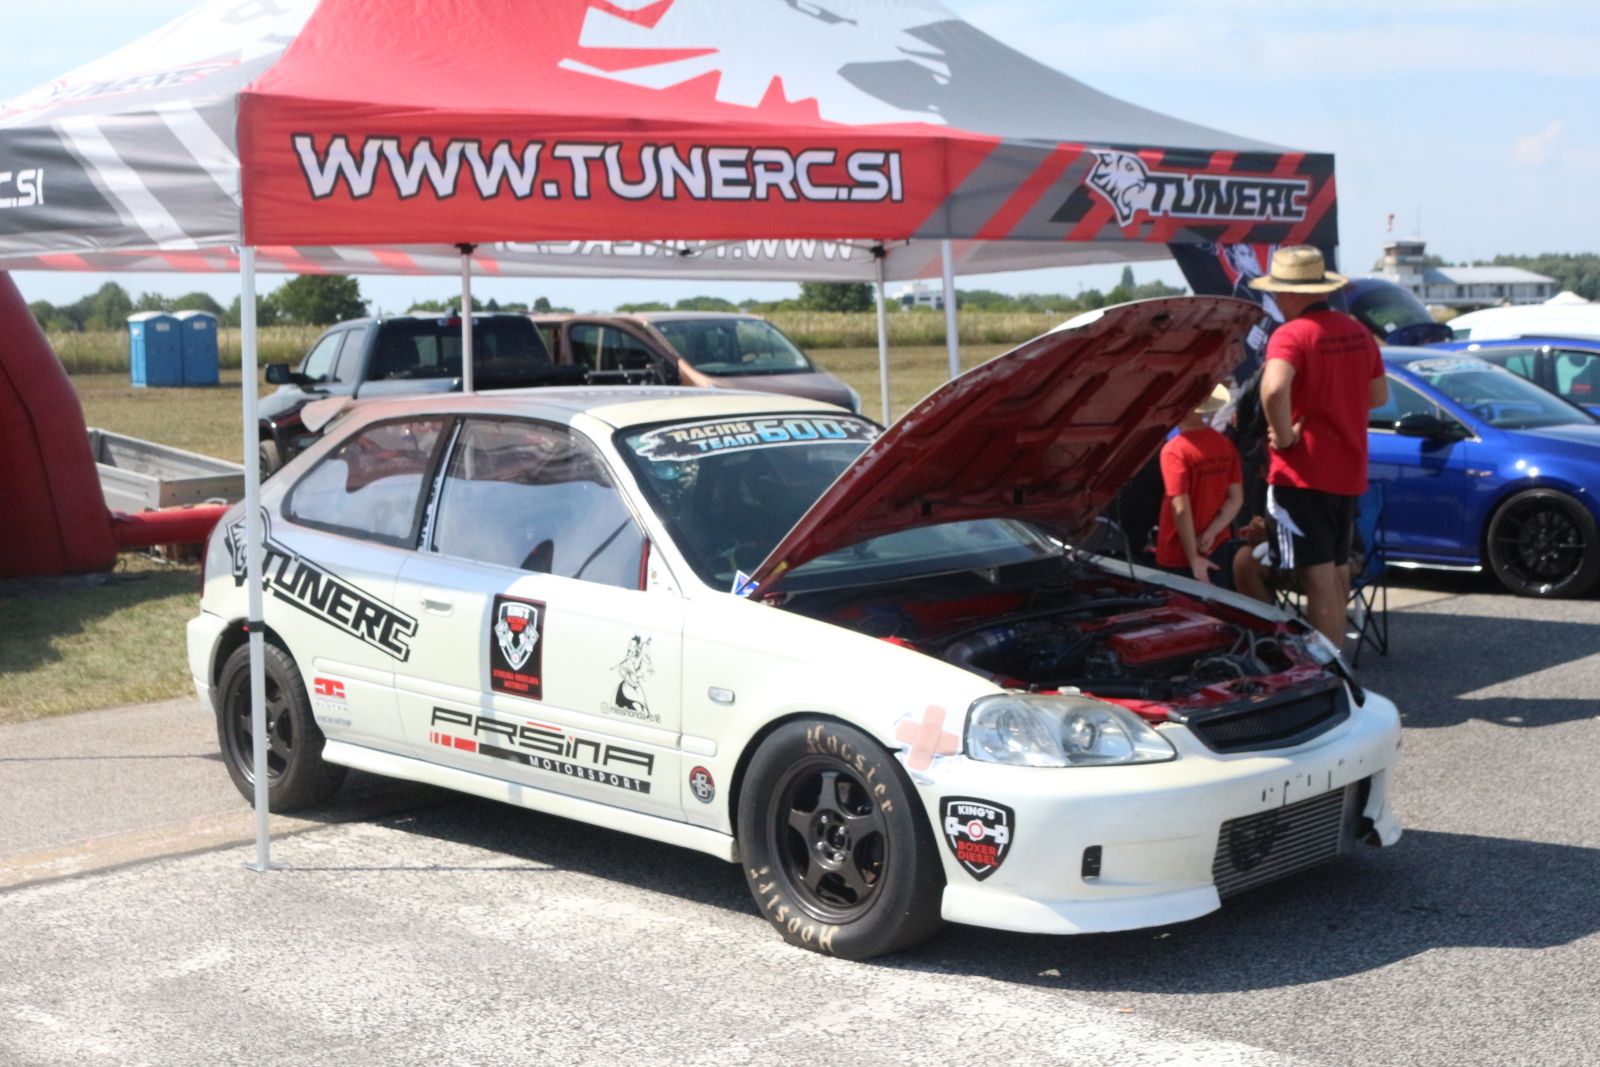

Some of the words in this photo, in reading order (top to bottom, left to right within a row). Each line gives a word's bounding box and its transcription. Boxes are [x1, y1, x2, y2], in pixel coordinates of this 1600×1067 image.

[292, 134, 903, 202] WWW.TUNERC.SI
[1147, 174, 1307, 219] TUNERC
[529, 754, 641, 791] MOTORSPORT
[957, 804, 996, 820] KING'S
[957, 839, 997, 857] BOXER
[957, 849, 999, 867] DIESEL
